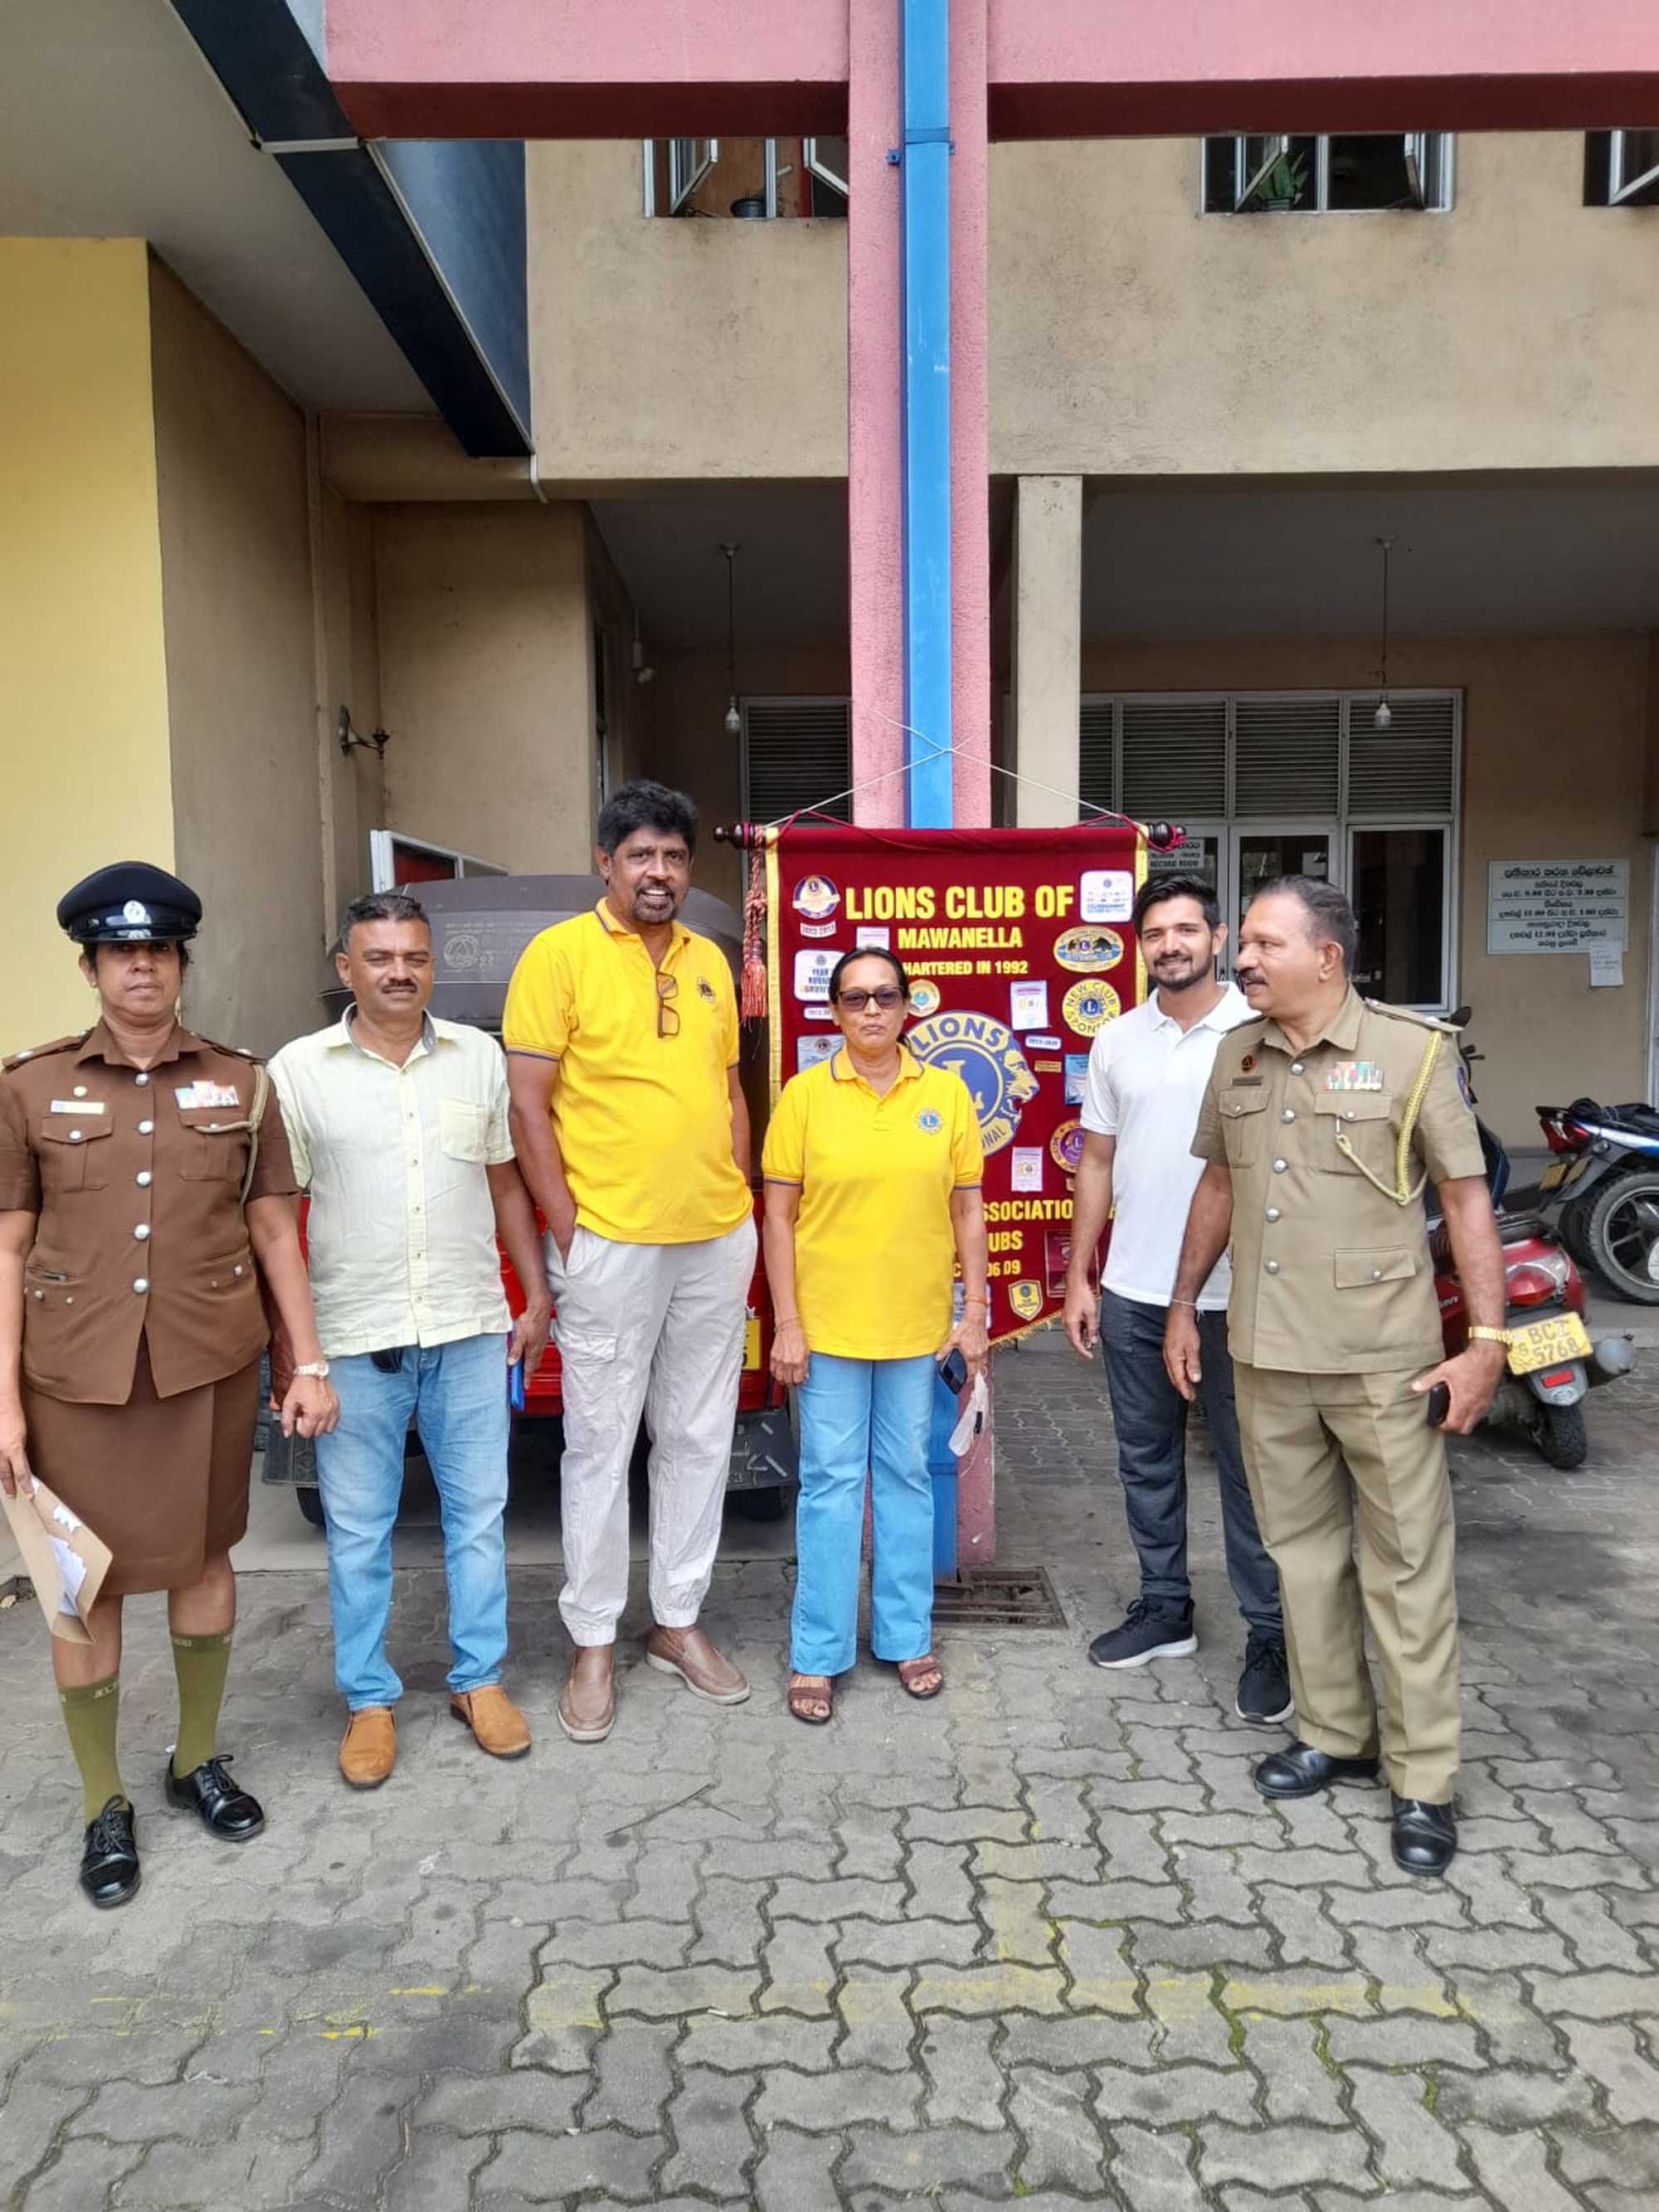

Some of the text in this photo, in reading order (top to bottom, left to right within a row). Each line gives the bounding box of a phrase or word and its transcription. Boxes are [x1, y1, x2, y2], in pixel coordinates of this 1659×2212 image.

[845, 887, 936, 920] LIONS
[945, 886, 1025, 919] CLUB
[1034, 885, 1075, 918] OF
[898, 927, 1023, 950] MAWANELLA
[902, 960, 1029, 976] HARTERED IN 1992
[1065, 982, 1116, 1007] NEW CLUB
[911, 1017, 1004, 1052] LIONS
[988, 1230, 1024, 1252] UBS
[1530, 1336, 1580, 1365] 5768
